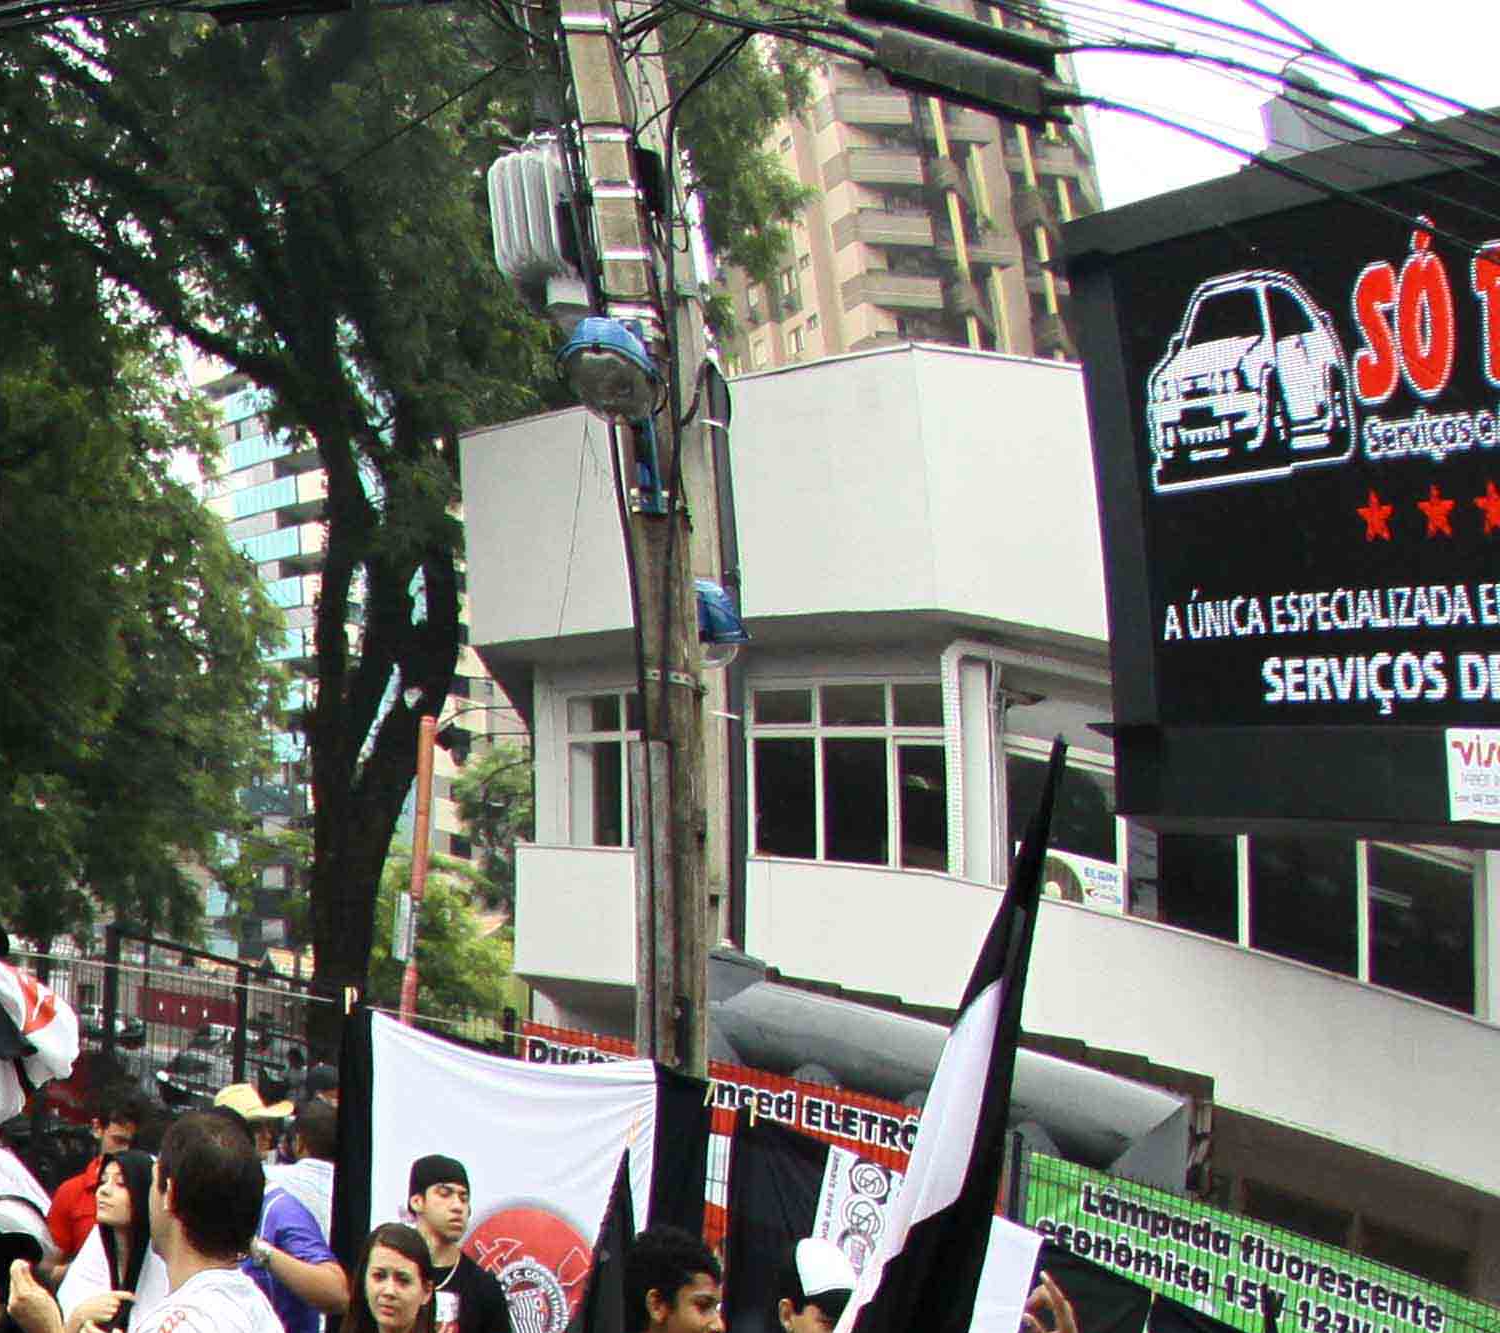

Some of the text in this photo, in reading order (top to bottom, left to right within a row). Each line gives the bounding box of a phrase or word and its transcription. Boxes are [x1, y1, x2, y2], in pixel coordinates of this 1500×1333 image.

[1352, 214, 1455, 404] SÓ
[1163, 583, 1500, 641] A ÚNICA ESPECIALIZADA E
[1260, 651, 1448, 714] SERVIÇOS
[1036, 1218, 1210, 1295] econômica
[1082, 1183, 1444, 1333] Lâmpada fluorescente
